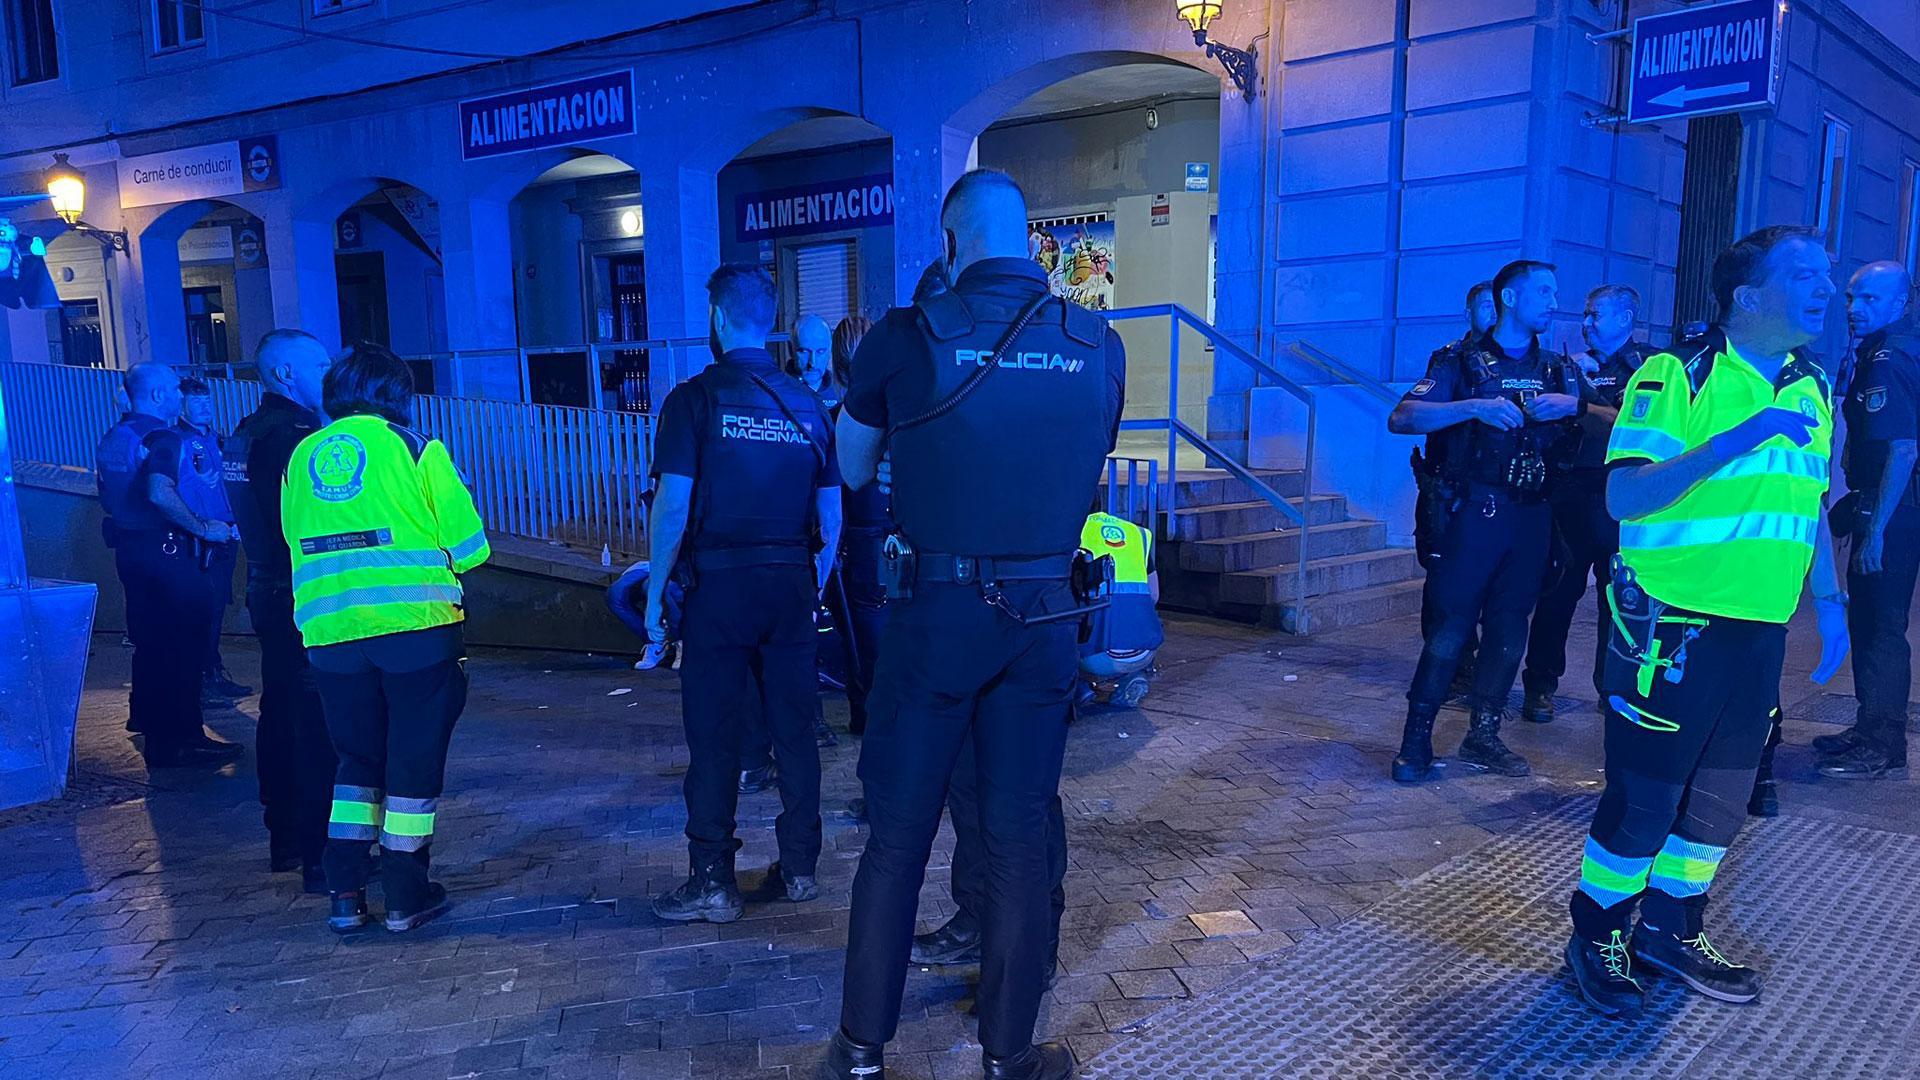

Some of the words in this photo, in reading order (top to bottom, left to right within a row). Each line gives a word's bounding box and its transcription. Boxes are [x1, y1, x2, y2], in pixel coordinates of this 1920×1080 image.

[1639, 17, 1766, 79] ALIMENTACION
[470, 86, 625, 147] ALIMENTACION
[133, 165, 165, 184] Carné
[168, 165, 181, 179] de
[184, 156, 232, 177] conducir
[722, 414, 795, 431] POLICIA
[722, 426, 811, 444] NACIONAL
